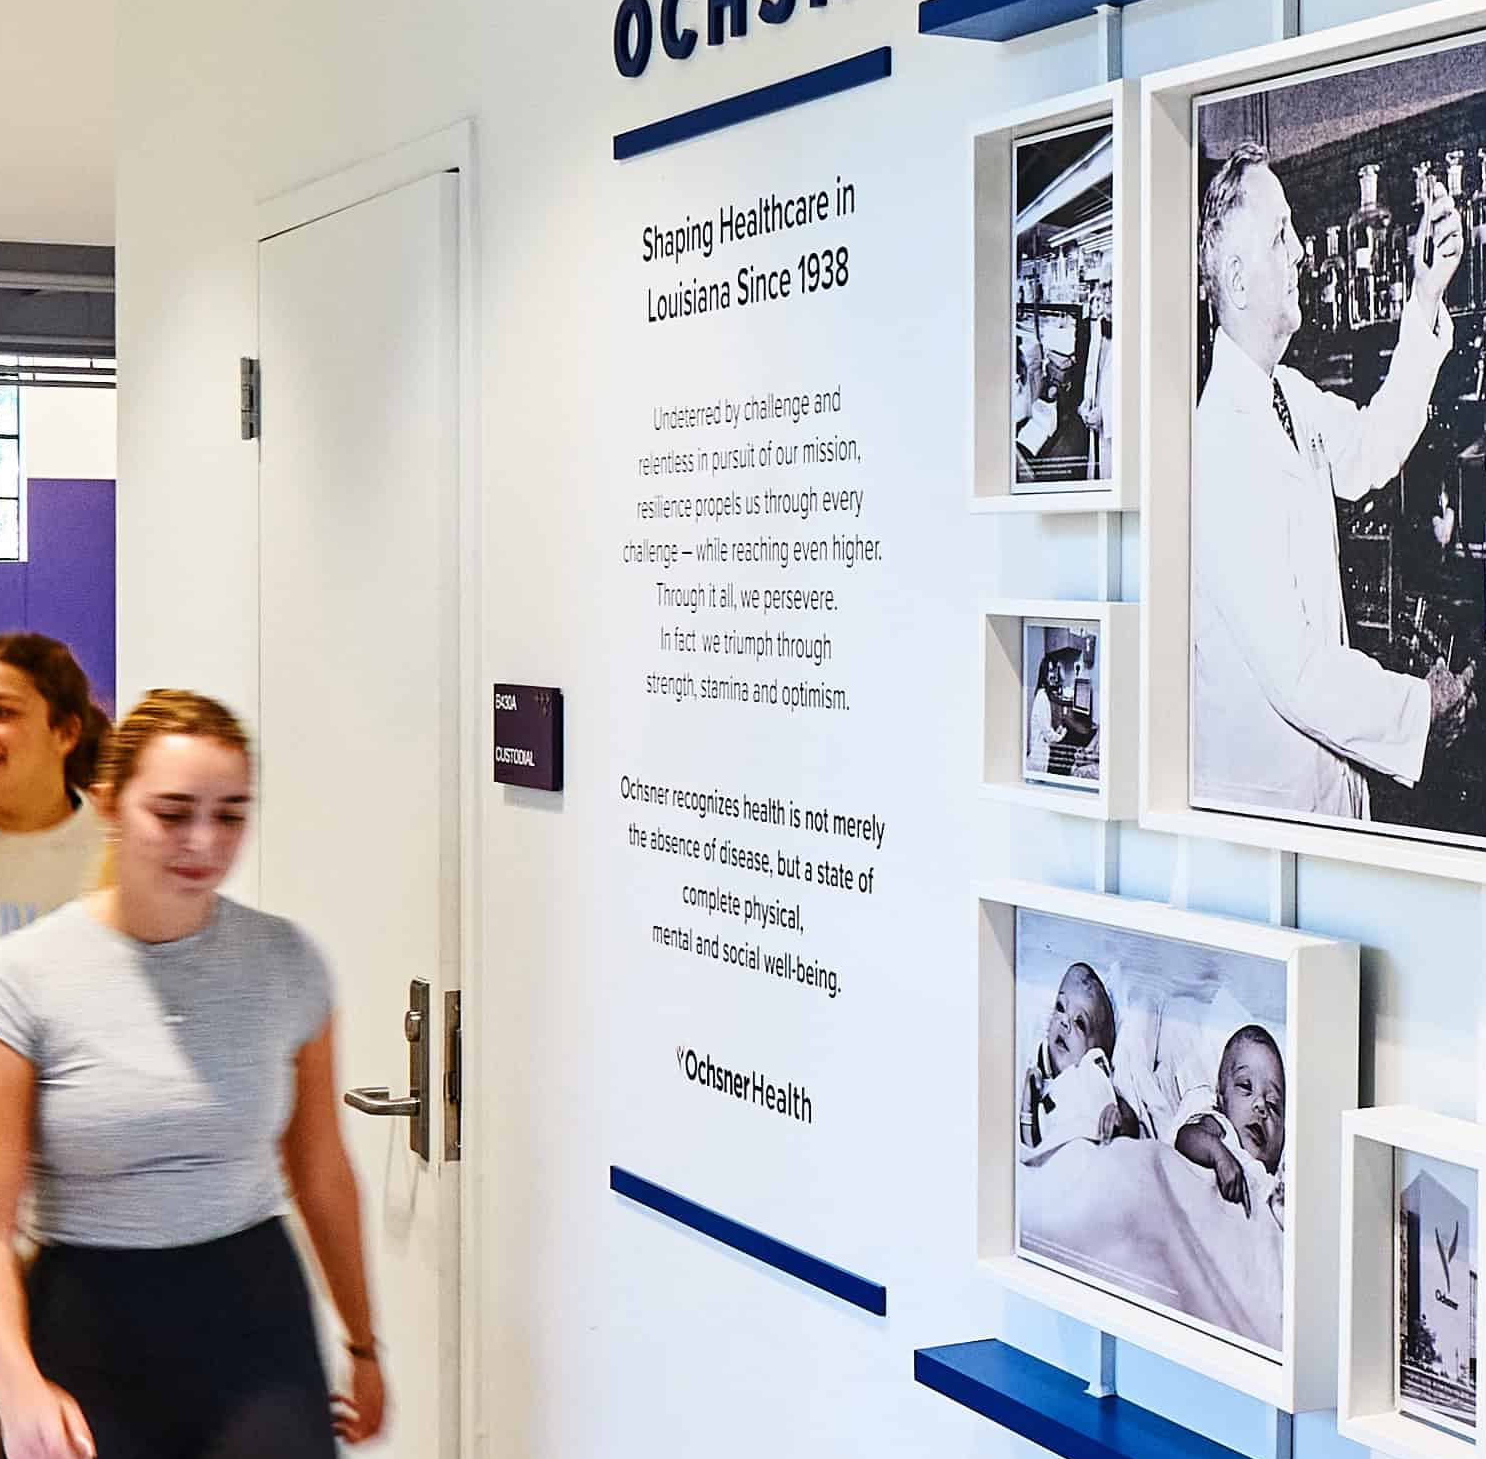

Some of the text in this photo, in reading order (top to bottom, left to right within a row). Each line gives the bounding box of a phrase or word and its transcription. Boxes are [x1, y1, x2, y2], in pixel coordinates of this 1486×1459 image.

[642, 175, 855, 263] Shaping Healthcare in
[648, 246, 850, 323] Louisiana Since 1938
[653, 385, 841, 430] Undeterred by challenge and
[639, 435, 861, 477] relentless in pursuit of our mission,
[637, 486, 864, 523] resilience propels us through every
[623, 538, 678, 568] challenge
[696, 537, 727, 561] while
[732, 536, 789, 568] reaching
[794, 540, 827, 561] even
[833, 534, 882, 568] higher.
[656, 582, 838, 614] Through it all, we persevere.
[661, 626, 671, 651] In
[702, 633, 721, 653] we
[724, 630, 773, 662] triumph
[777, 632, 832, 666] through
[646, 672, 850, 712] strength, stamina and optimism.
[495, 746, 536, 767] CUSTODIAL
[621, 775, 885, 850] Ochsner recognizes health is not merely
[629, 822, 874, 894] the absence of disease, but a state of
[683, 884, 804, 935] complete physical,
[652, 924, 842, 999] mental and social well-being.
